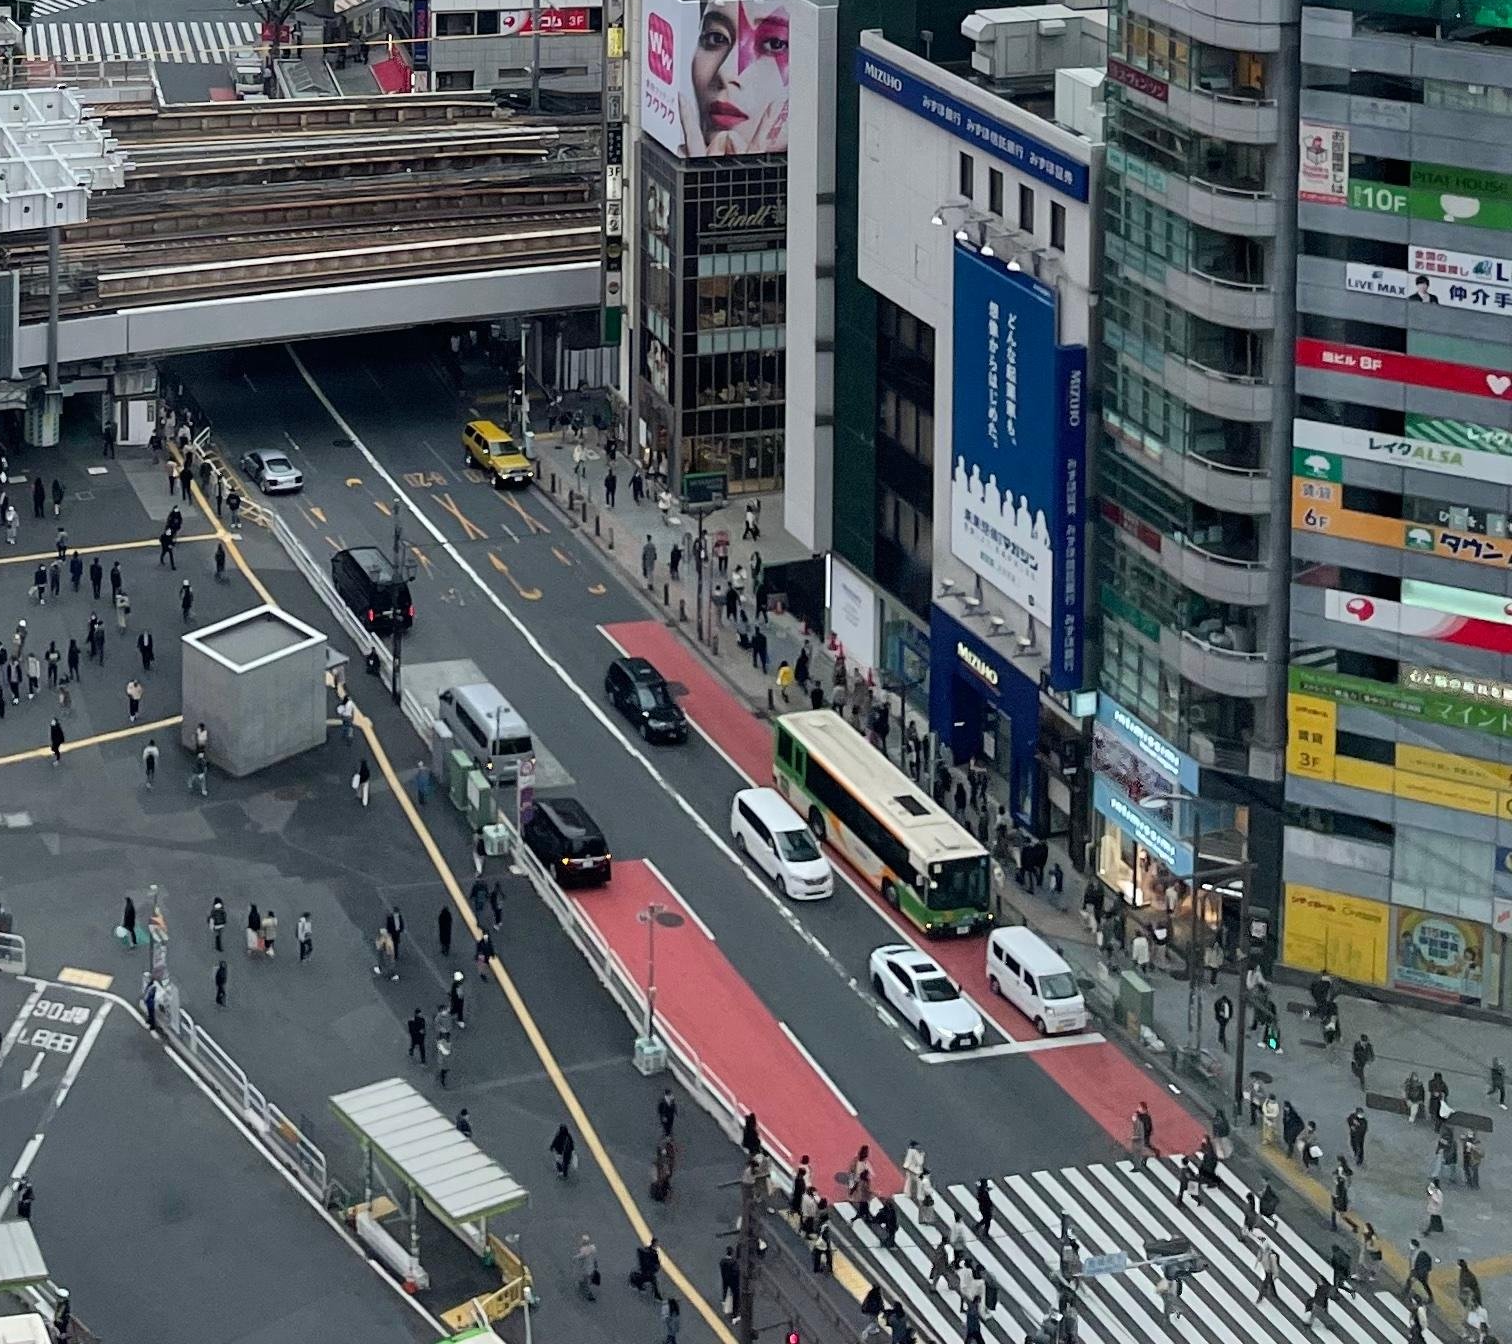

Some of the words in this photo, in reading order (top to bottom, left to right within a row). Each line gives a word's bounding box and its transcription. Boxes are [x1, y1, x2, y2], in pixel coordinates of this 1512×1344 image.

[568, 15, 585, 28] 3F
[864, 60, 903, 93] MIZUHO
[608, 167, 620, 177] 3F
[1363, 187, 1408, 213] 10F
[708, 204, 774, 230] Lindt
[1377, 284, 1406, 296] MAX
[1069, 369, 1082, 427] MIZUHO
[1368, 437, 1412, 456] レイク
[1412, 447, 1464, 466] ALSA
[1304, 508, 1329, 528] 6F
[1439, 533, 1512, 564] タウン
[956, 642, 999, 685] MIZUHO
[1299, 752, 1320, 768] 3F
